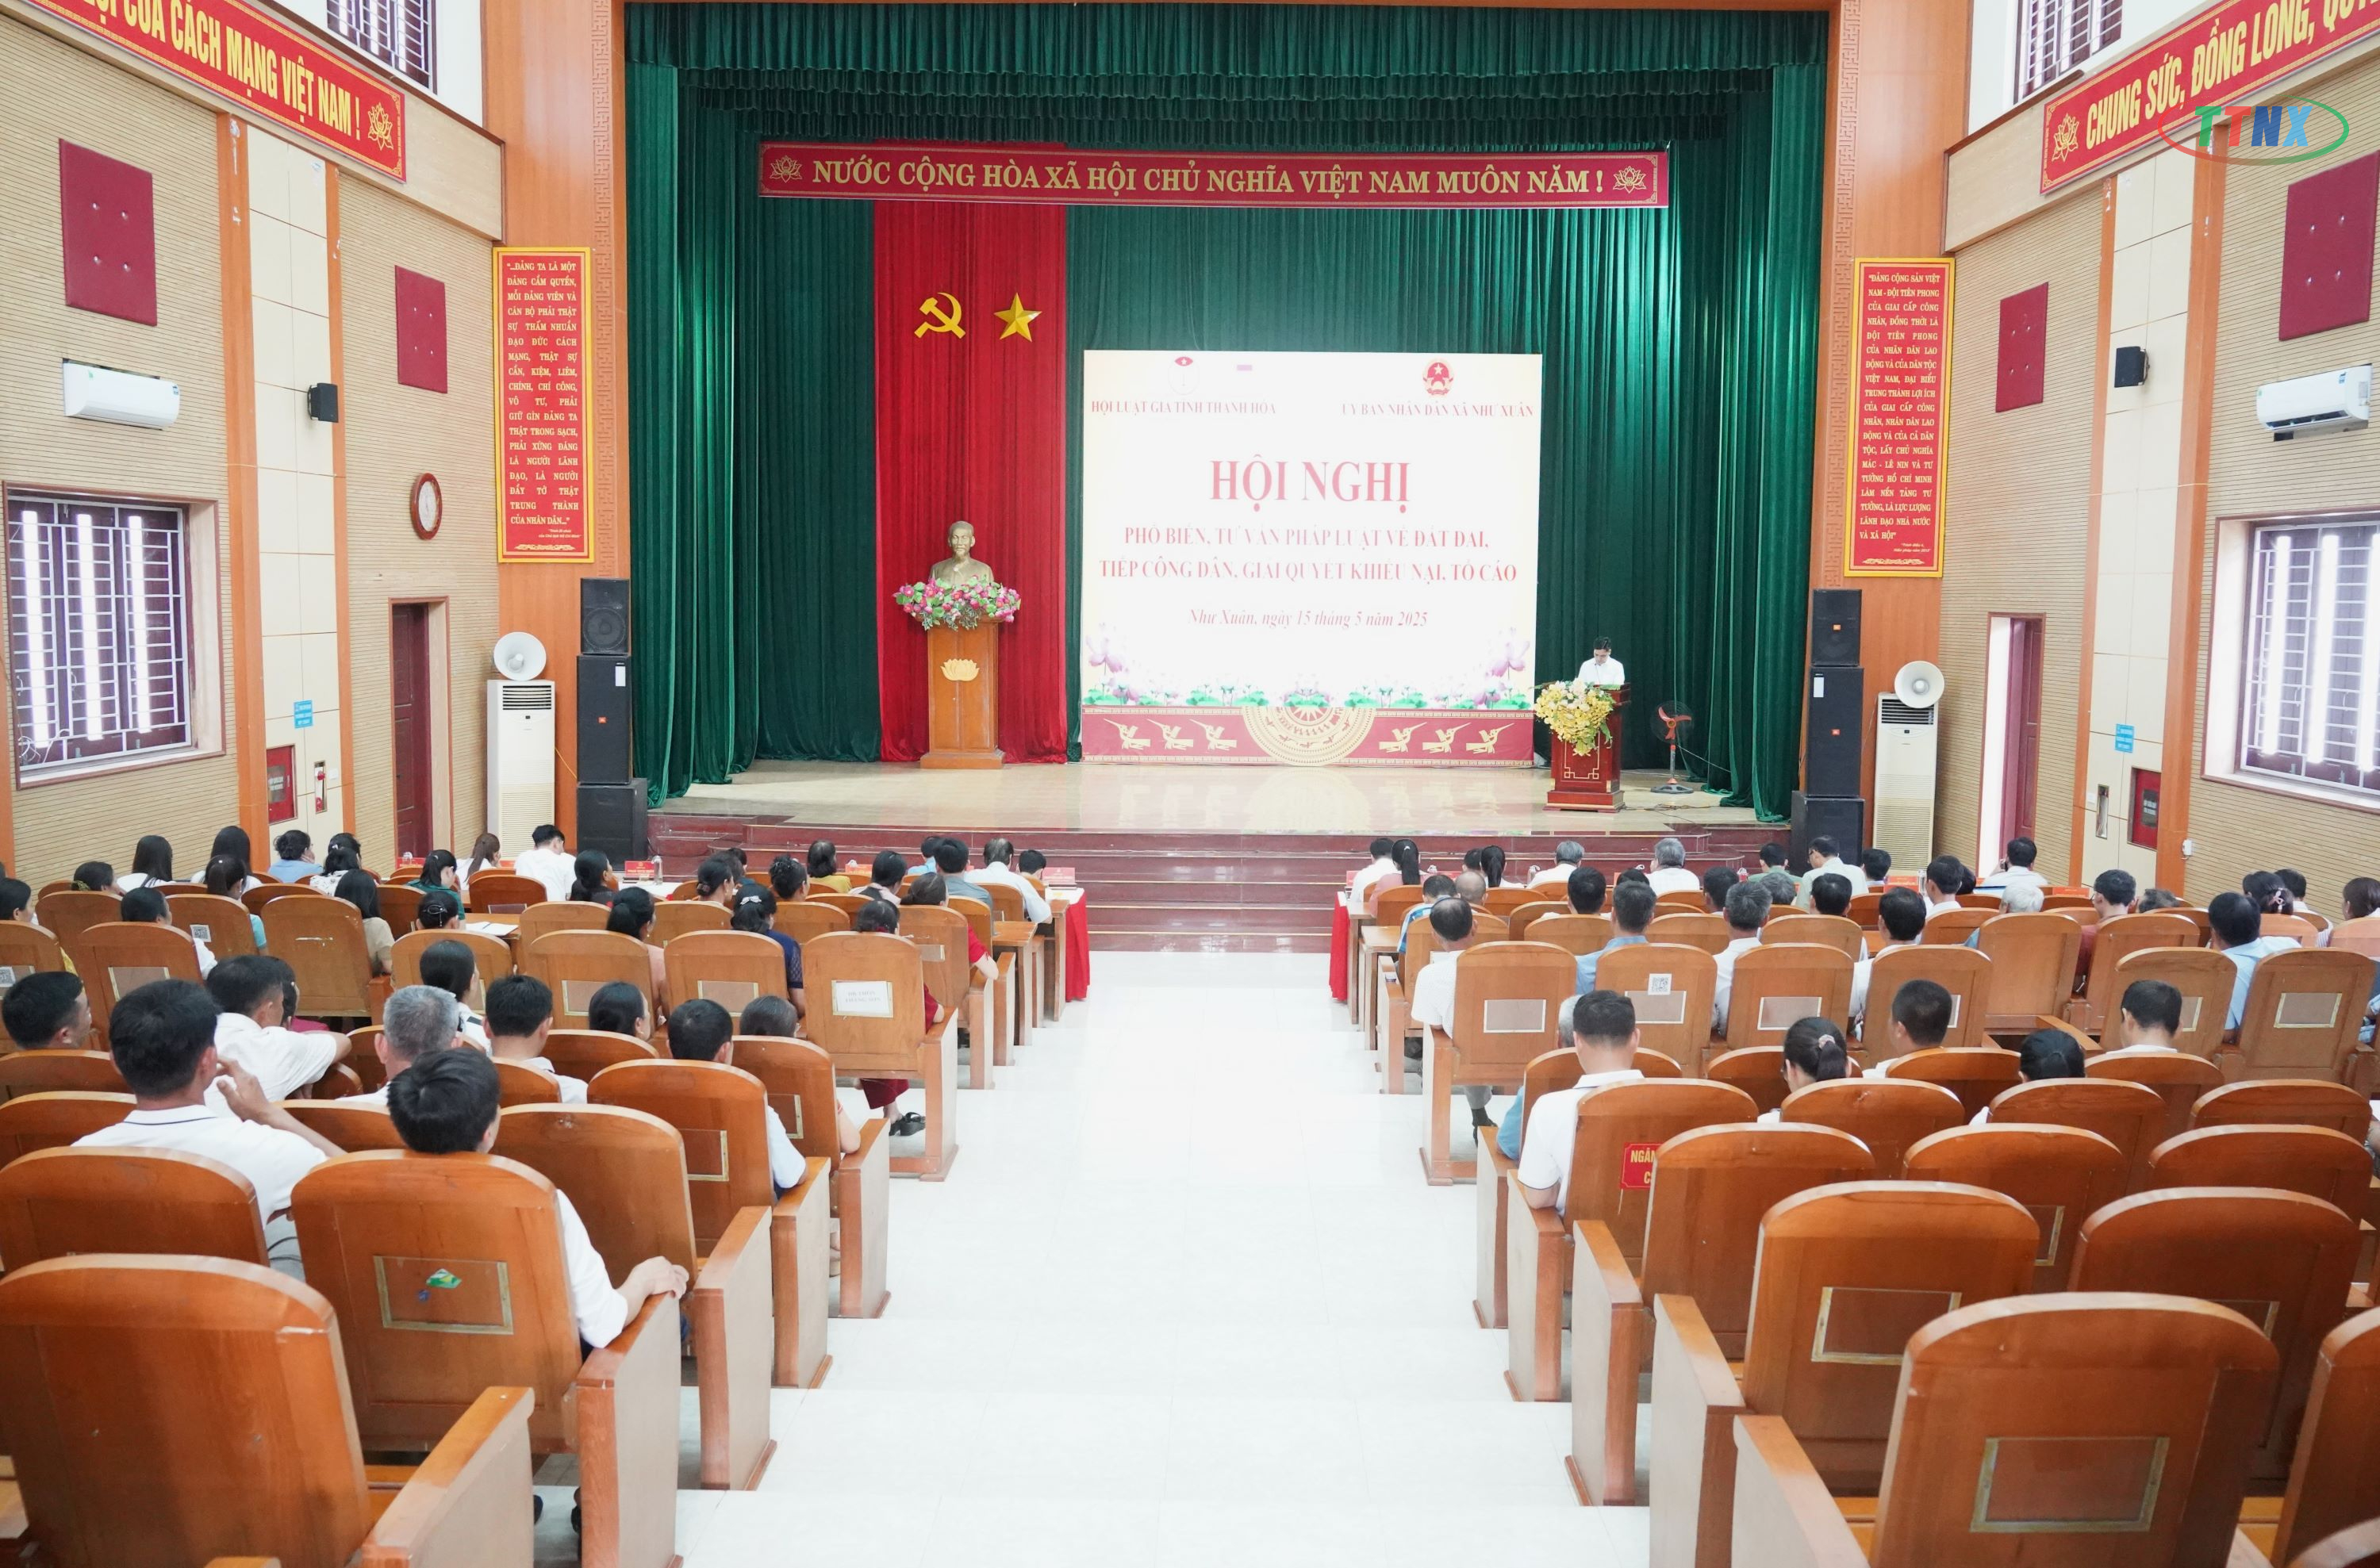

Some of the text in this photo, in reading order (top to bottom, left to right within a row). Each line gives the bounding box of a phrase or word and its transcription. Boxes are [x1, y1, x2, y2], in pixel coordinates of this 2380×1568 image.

[227, 27, 278, 99] MẠNG
[282, 56, 314, 123] VIỆT
[318, 79, 352, 136] NAM
[355, 97, 362, 140] !
[2086, 79, 2142, 151] CHUNG
[2145, 52, 2186, 120] SỨC,
[2191, 18, 2248, 98] ĐỒNG
[812, 154, 1603, 199] NƯỚC CỘNG HÒA XÃ HỘI CHỦ NGHĨA VIỆT NAM MUÔN NĂM !
[1209, 454, 1411, 513] HỘI NGHỊ
[1142, 555, 1192, 578] CÔNG
[1479, 559, 1518, 582] CÁO
[1297, 610, 1311, 626] 15
[1354, 611, 1363, 627] 5
[1398, 611, 1429, 627] 2025
